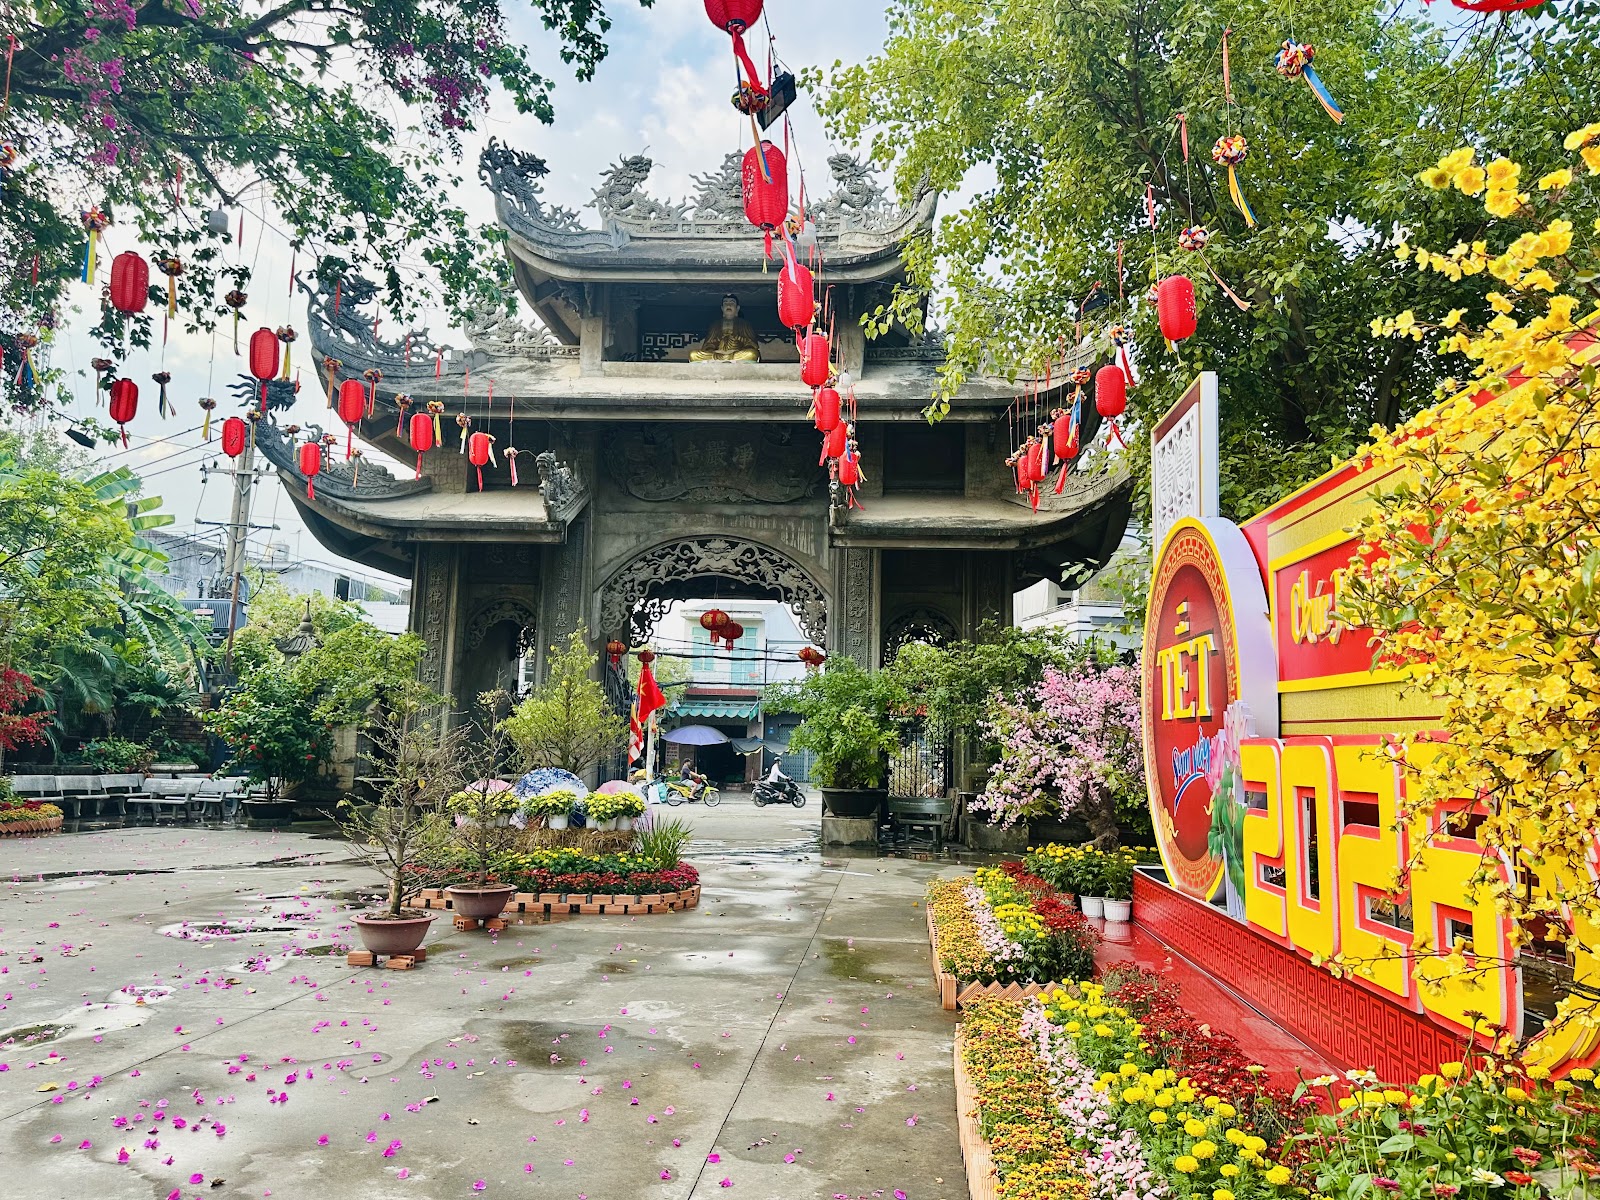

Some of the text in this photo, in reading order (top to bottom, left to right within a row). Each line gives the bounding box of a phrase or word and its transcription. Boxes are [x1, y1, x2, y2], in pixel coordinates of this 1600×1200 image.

[1291, 569, 1333, 645] Chúc
[1157, 600, 1218, 722] TẾT
[1172, 746, 1191, 789] Sum
[1240, 733, 1523, 1051] 2026
